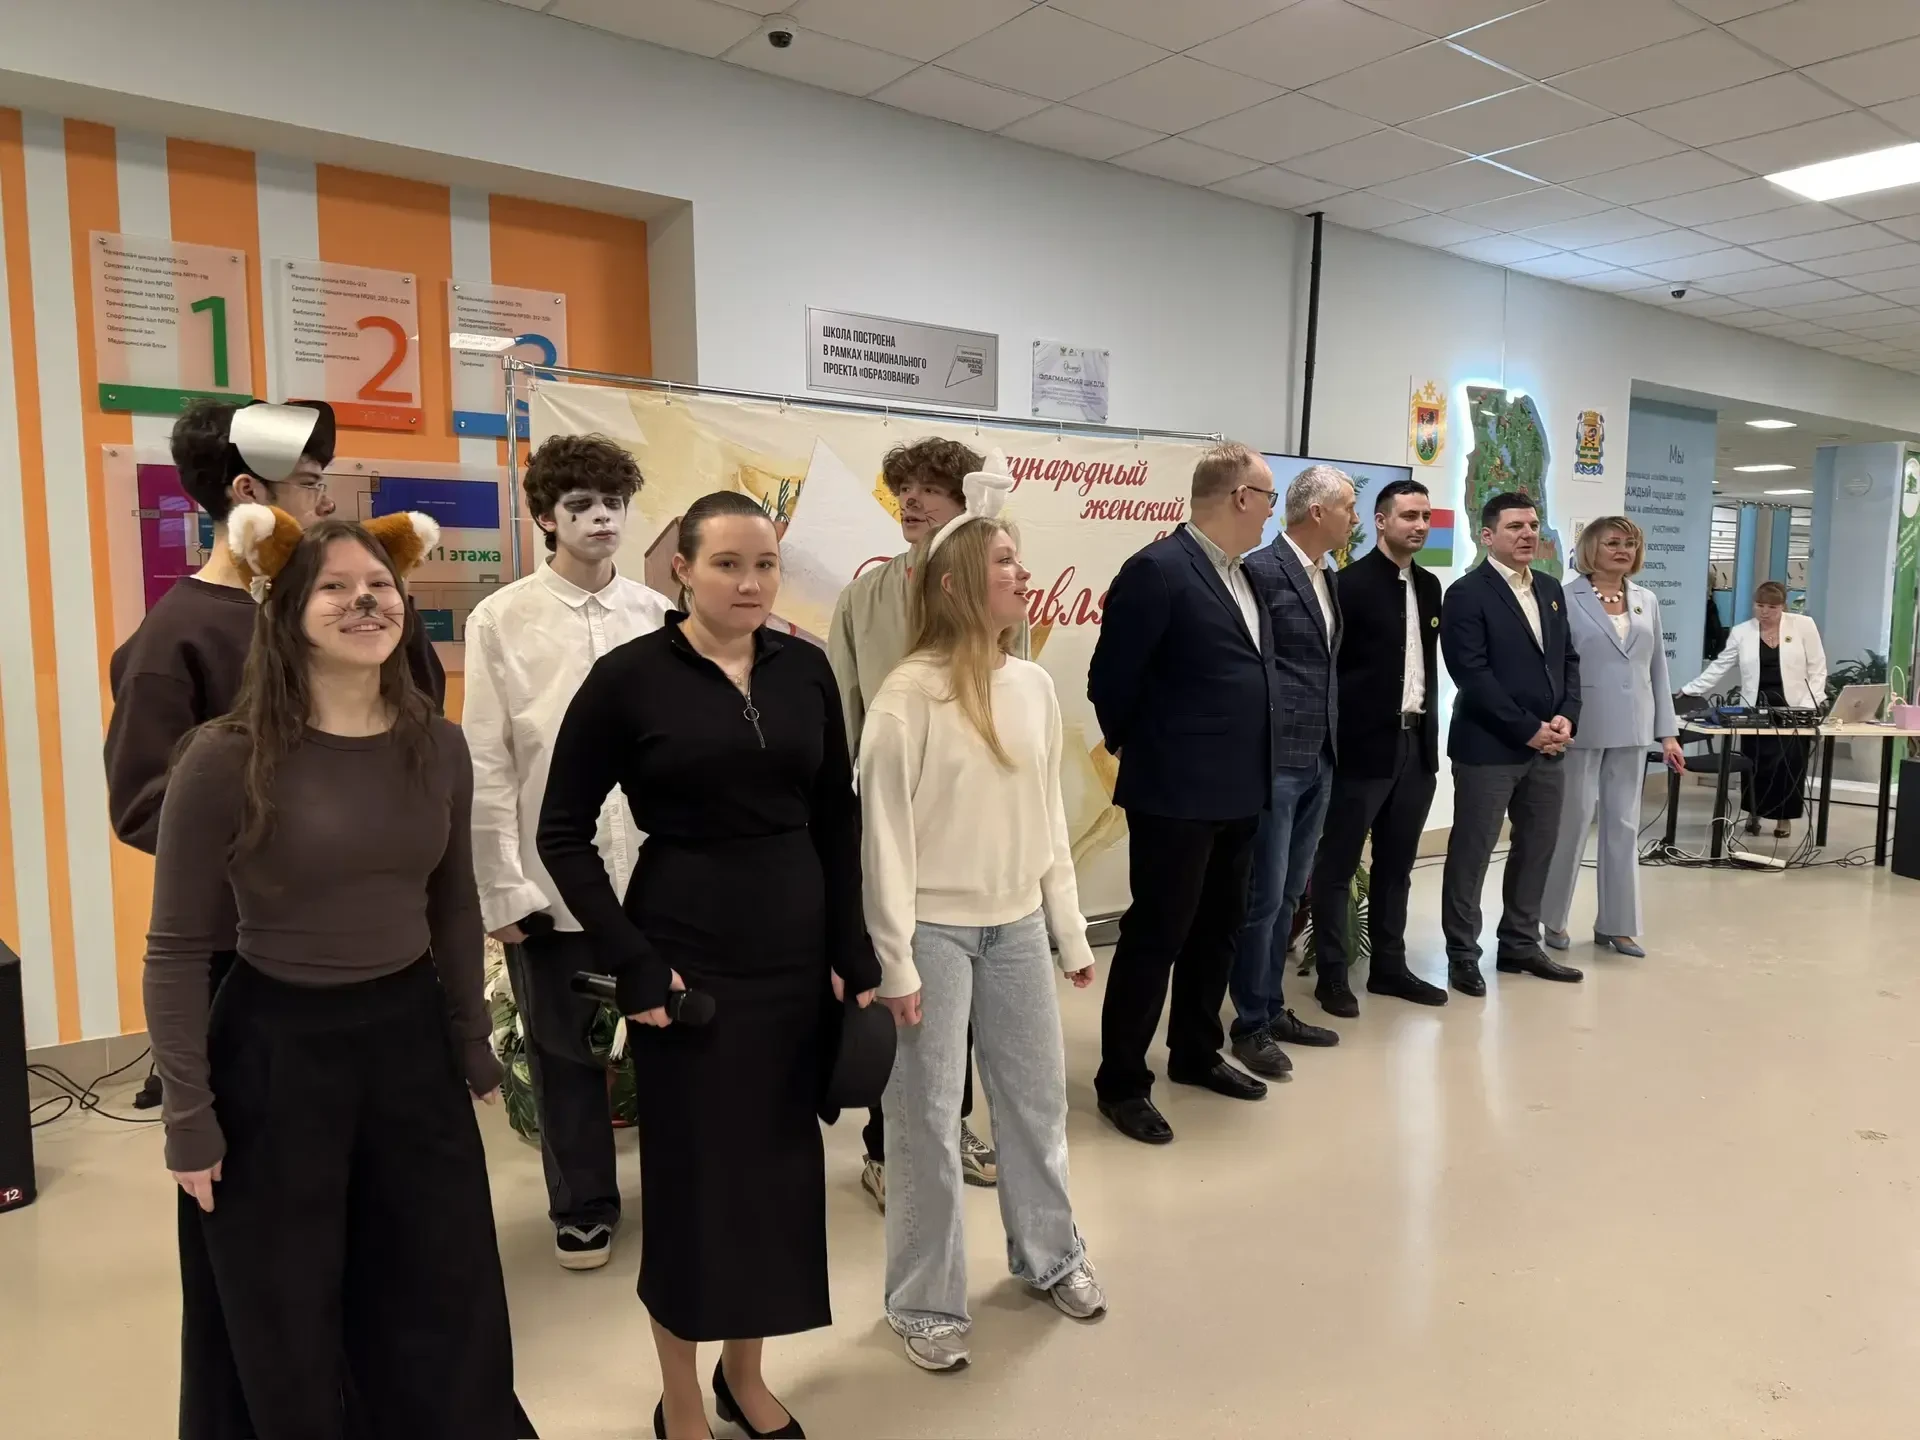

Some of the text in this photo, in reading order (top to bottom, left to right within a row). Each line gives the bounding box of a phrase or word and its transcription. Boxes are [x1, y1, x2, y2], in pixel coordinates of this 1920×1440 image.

[104, 273, 143, 284] Спортивный
[105, 286, 143, 296] Спортивный
[106, 312, 144, 322] Спортивный
[293, 308, 325, 317] Библиотека
[190, 295, 229, 387] 1
[823, 325, 896, 348] ШКОЛА ПОСТРОЕНА
[356, 315, 413, 403] 2
[823, 344, 927, 369] В РАМКАХ НАЦИОНАЛЬНОГО
[823, 362, 920, 386] ПРОЕКТА «ОБРАЗОВАНИЕ»
[1039, 373, 1105, 388] ФЛАГМАНСКАЯ ШКОЛА
[1669, 444, 1684, 465] Мы
[1005, 456, 1148, 497] ународный
[1625, 485, 1651, 499] АЖДЫЙ
[1079, 496, 1185, 522] женский
[437, 546, 444, 561] 1
[450, 550, 501, 562] этажа
[1647, 543, 1685, 554] всесторонне
[3, 1189, 19, 1202] 12
